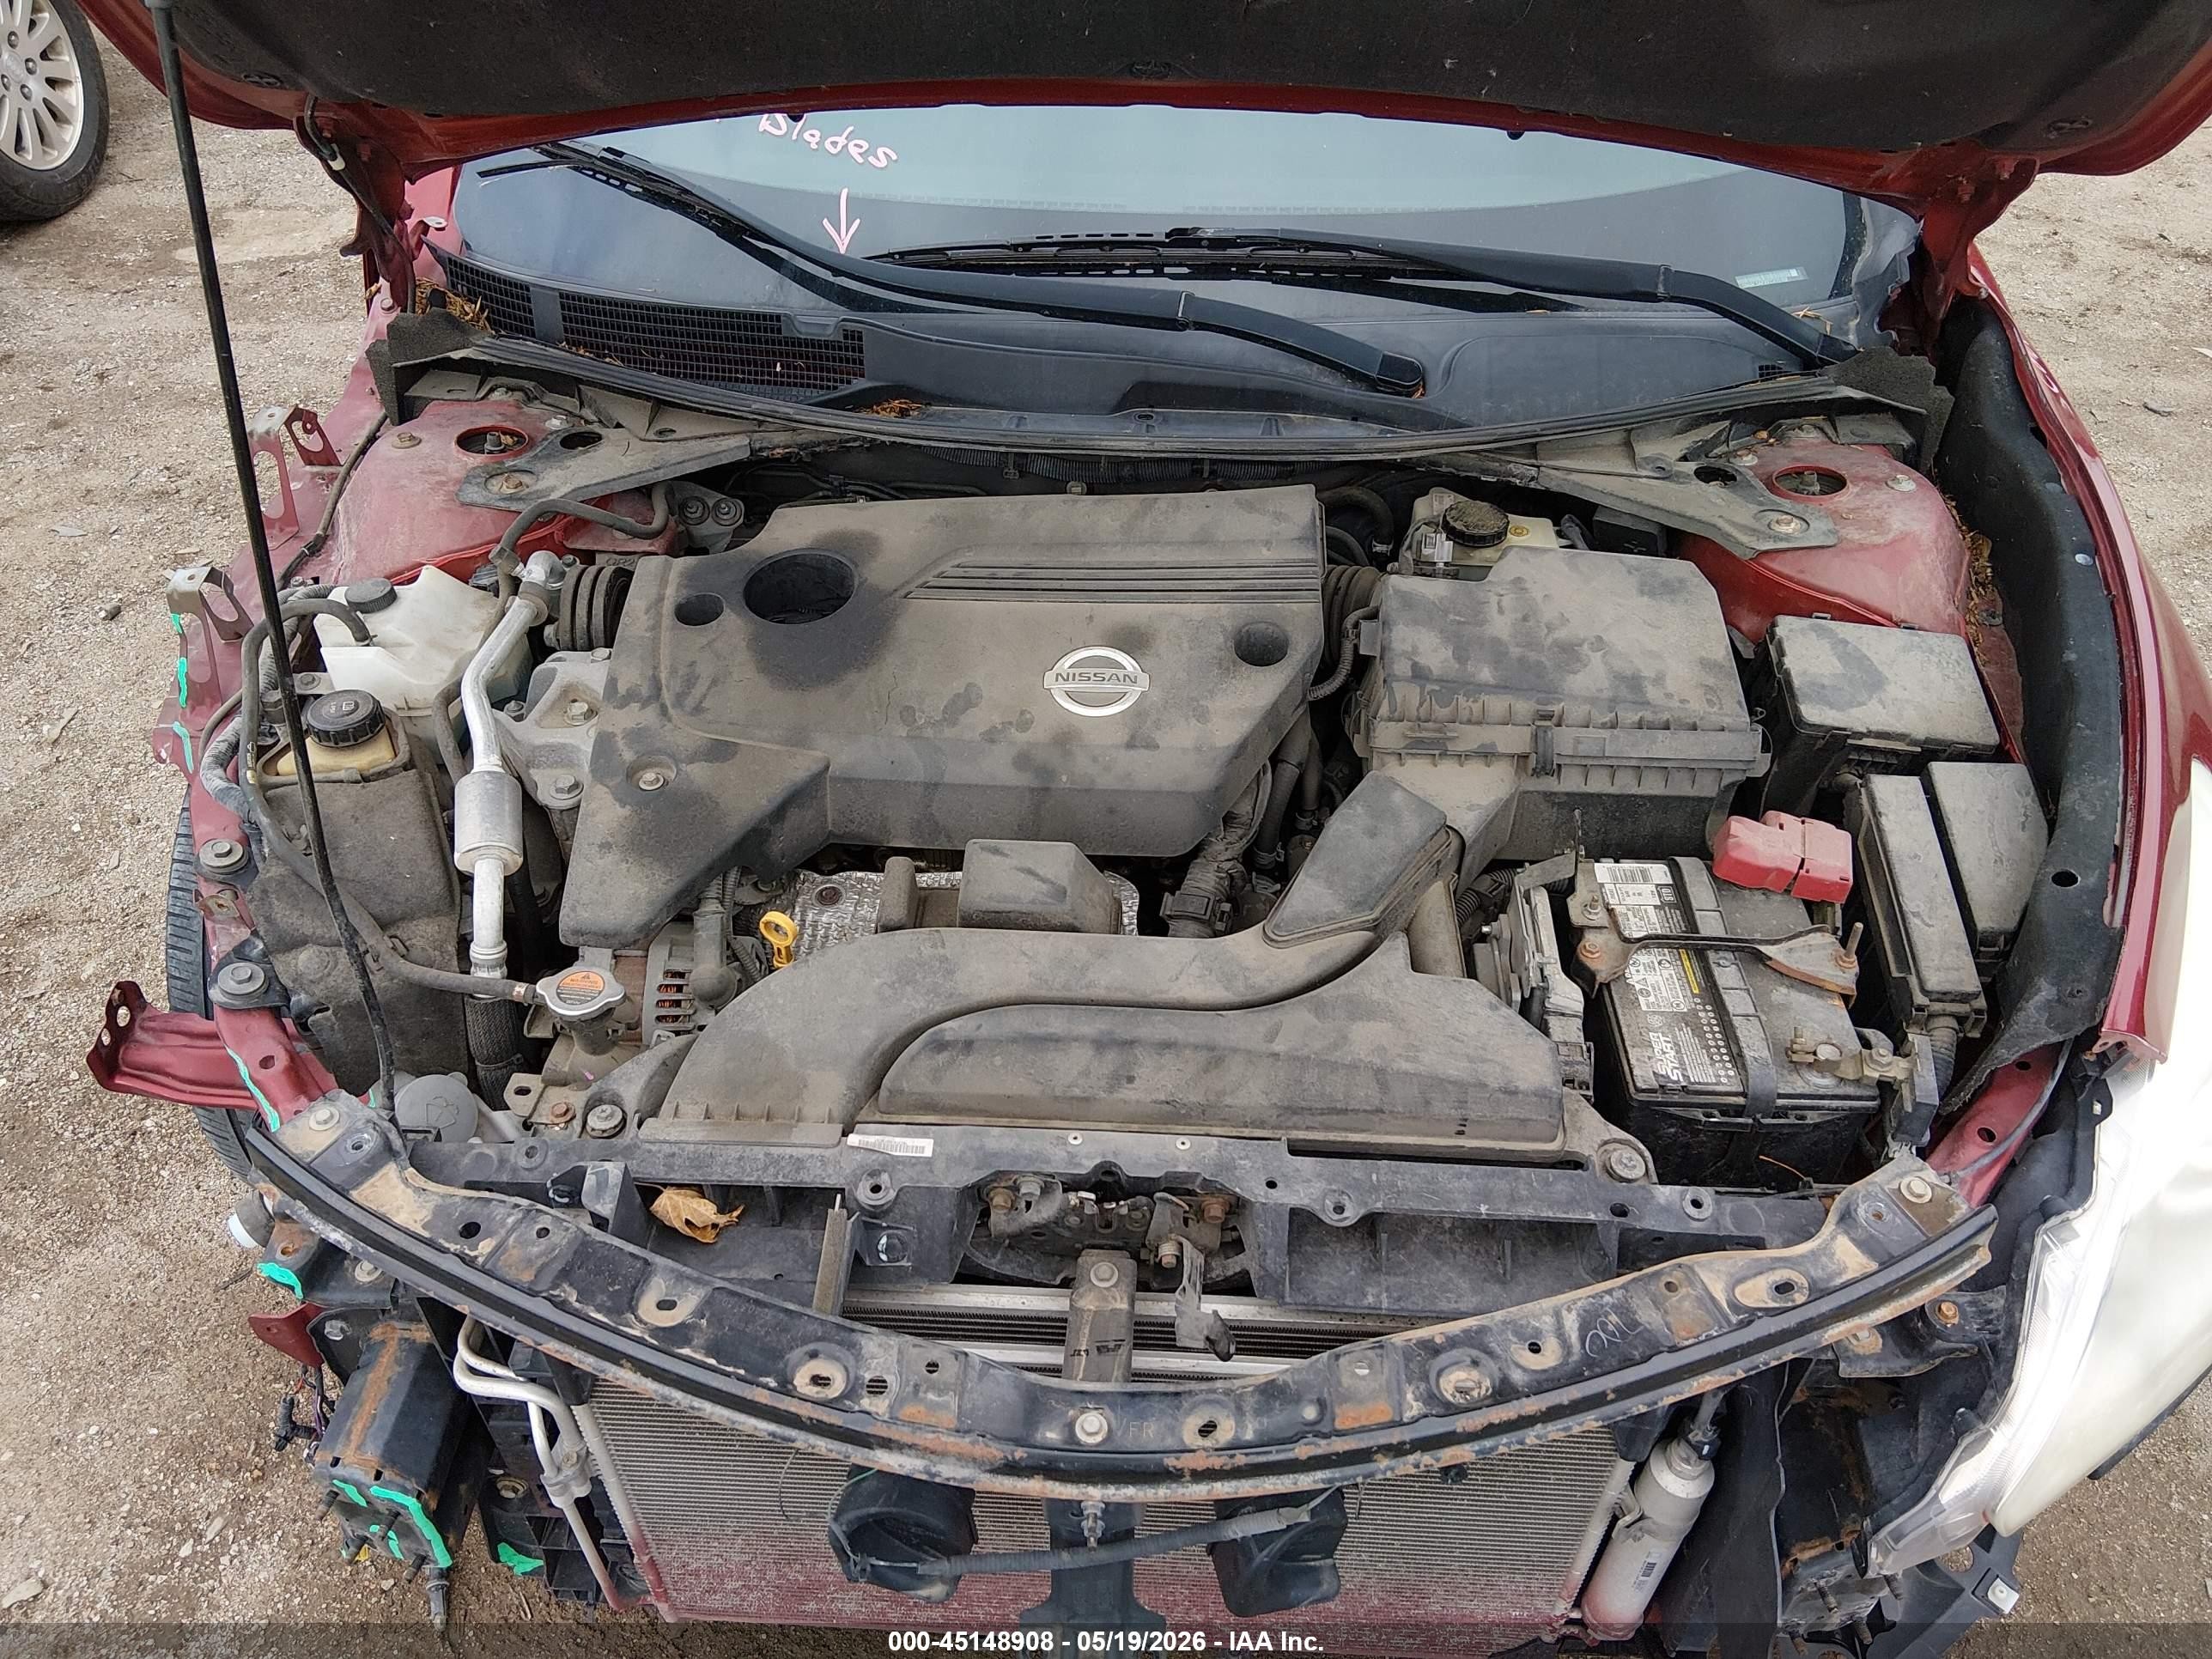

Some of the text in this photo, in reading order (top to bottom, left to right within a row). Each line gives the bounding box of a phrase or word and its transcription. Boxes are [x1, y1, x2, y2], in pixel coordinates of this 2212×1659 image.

[1054, 672, 1138, 684] NISSAN
[1649, 1032, 1667, 1074] SUPER
[1658, 1032, 1683, 1082] START
